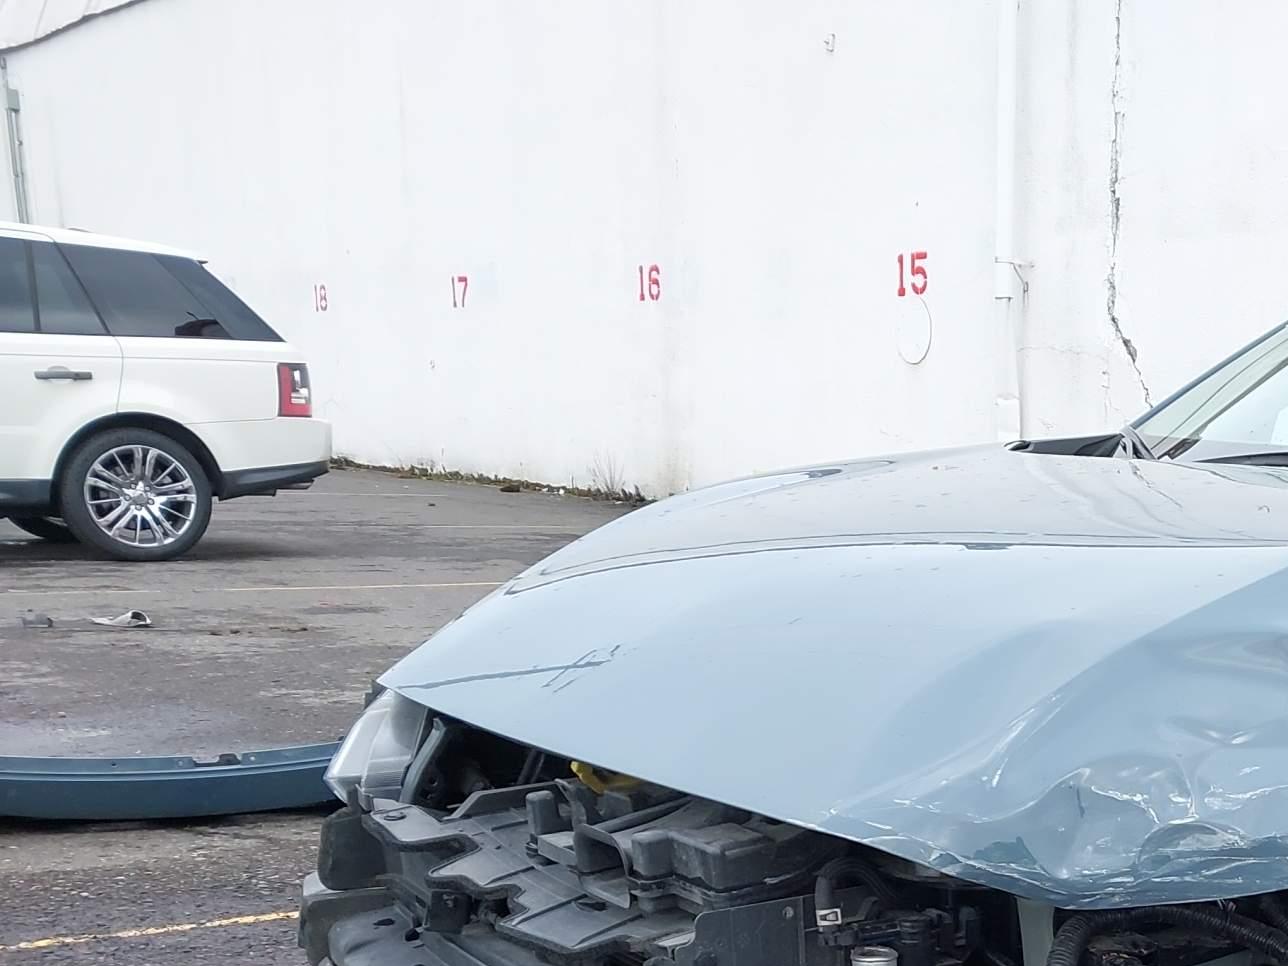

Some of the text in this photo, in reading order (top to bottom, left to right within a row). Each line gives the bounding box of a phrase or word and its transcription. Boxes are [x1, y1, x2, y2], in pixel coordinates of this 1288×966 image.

[638, 264, 661, 302] 16
[897, 251, 928, 297] 15
[314, 284, 328, 312] 18
[451, 276, 468, 308] 17
